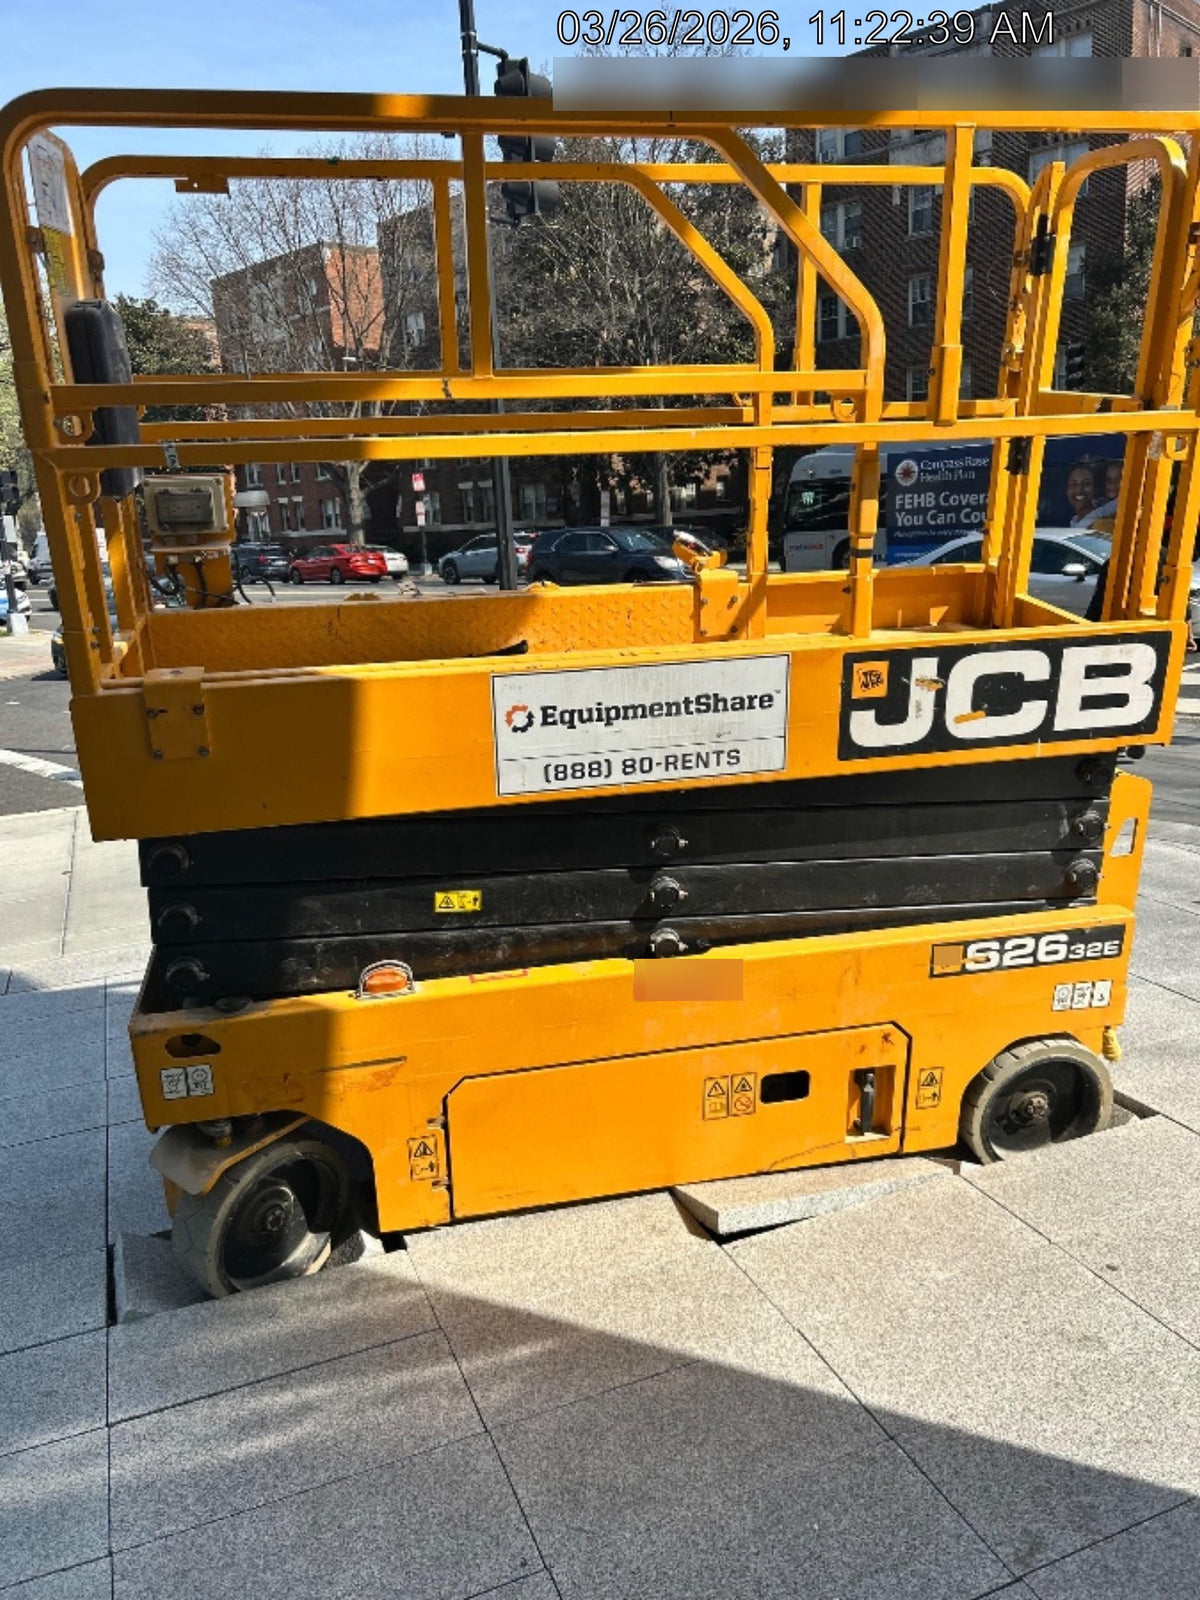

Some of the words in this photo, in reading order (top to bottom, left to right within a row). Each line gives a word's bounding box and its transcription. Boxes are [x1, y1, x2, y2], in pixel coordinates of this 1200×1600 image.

[920, 458, 964, 471] Compass
[920, 470, 953, 483] Health
[895, 492, 936, 509] FEHB
[895, 511, 924, 527] You
[926, 509, 956, 525] Can
[848, 642, 1155, 748] JCB
[540, 692, 775, 730] EquipmentShare
[543, 758, 613, 784] (888)
[621, 749, 742, 776] 80-RENTS
